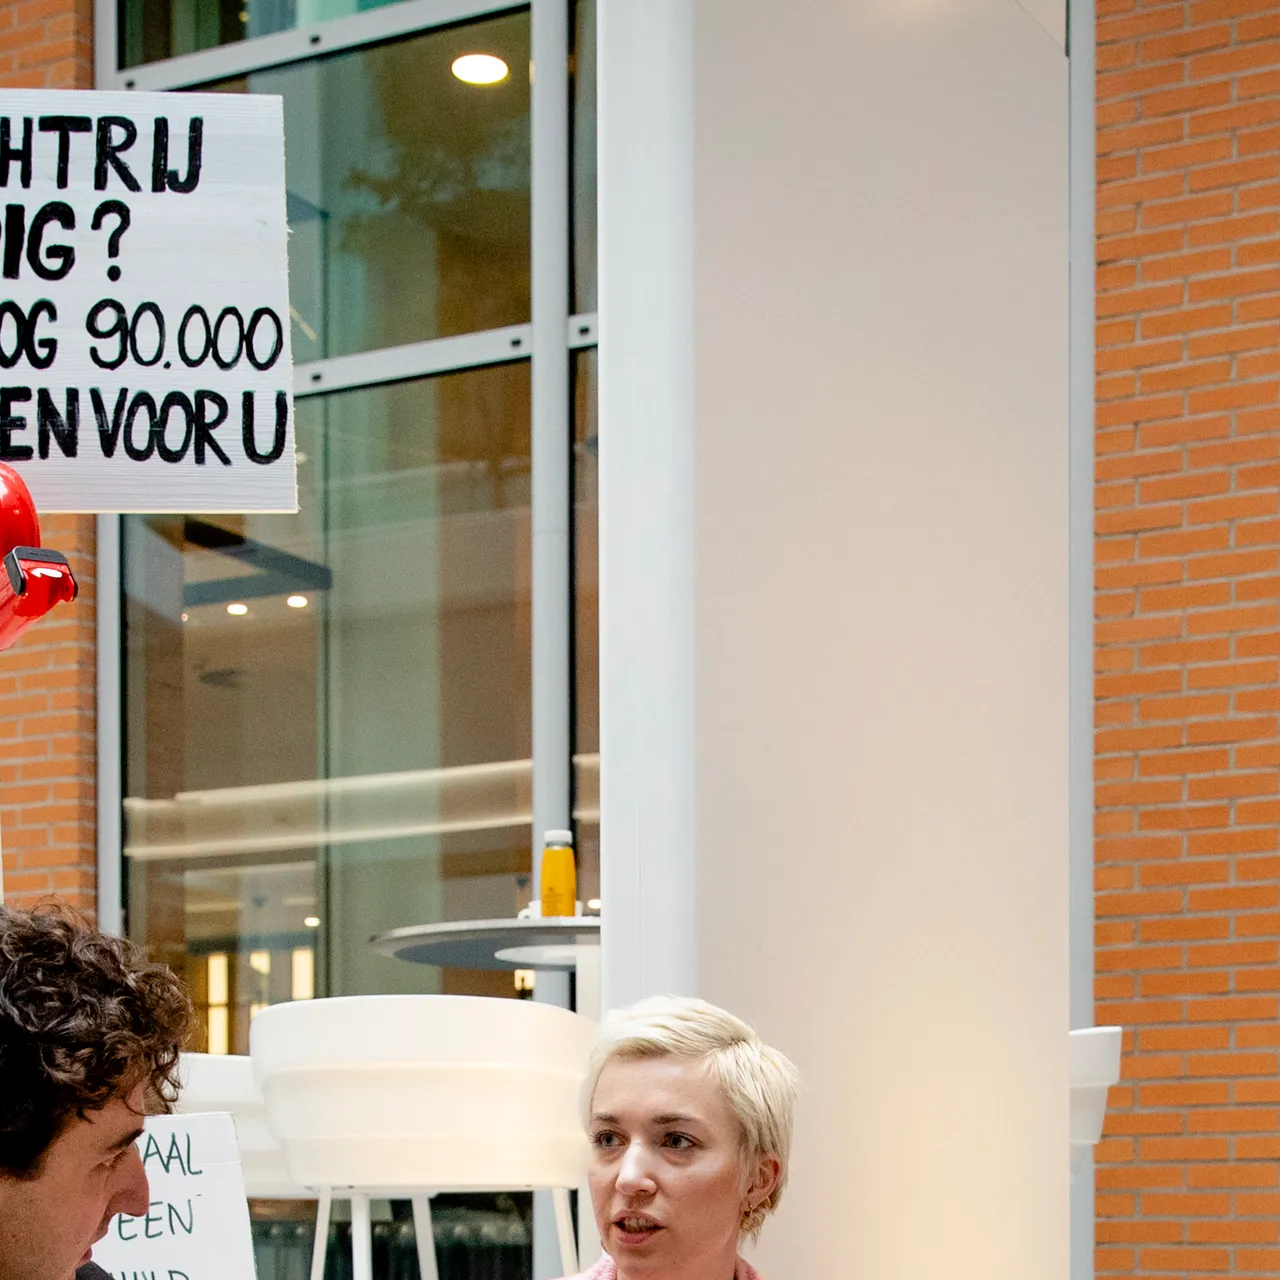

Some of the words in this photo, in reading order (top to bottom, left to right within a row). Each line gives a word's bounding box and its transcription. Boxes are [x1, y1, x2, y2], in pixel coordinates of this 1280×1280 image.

[86, 299, 283, 370] 90.000
[90, 388, 231, 465] VOOR
[242, 391, 288, 464] U
[133, 1131, 203, 1177] AAL
